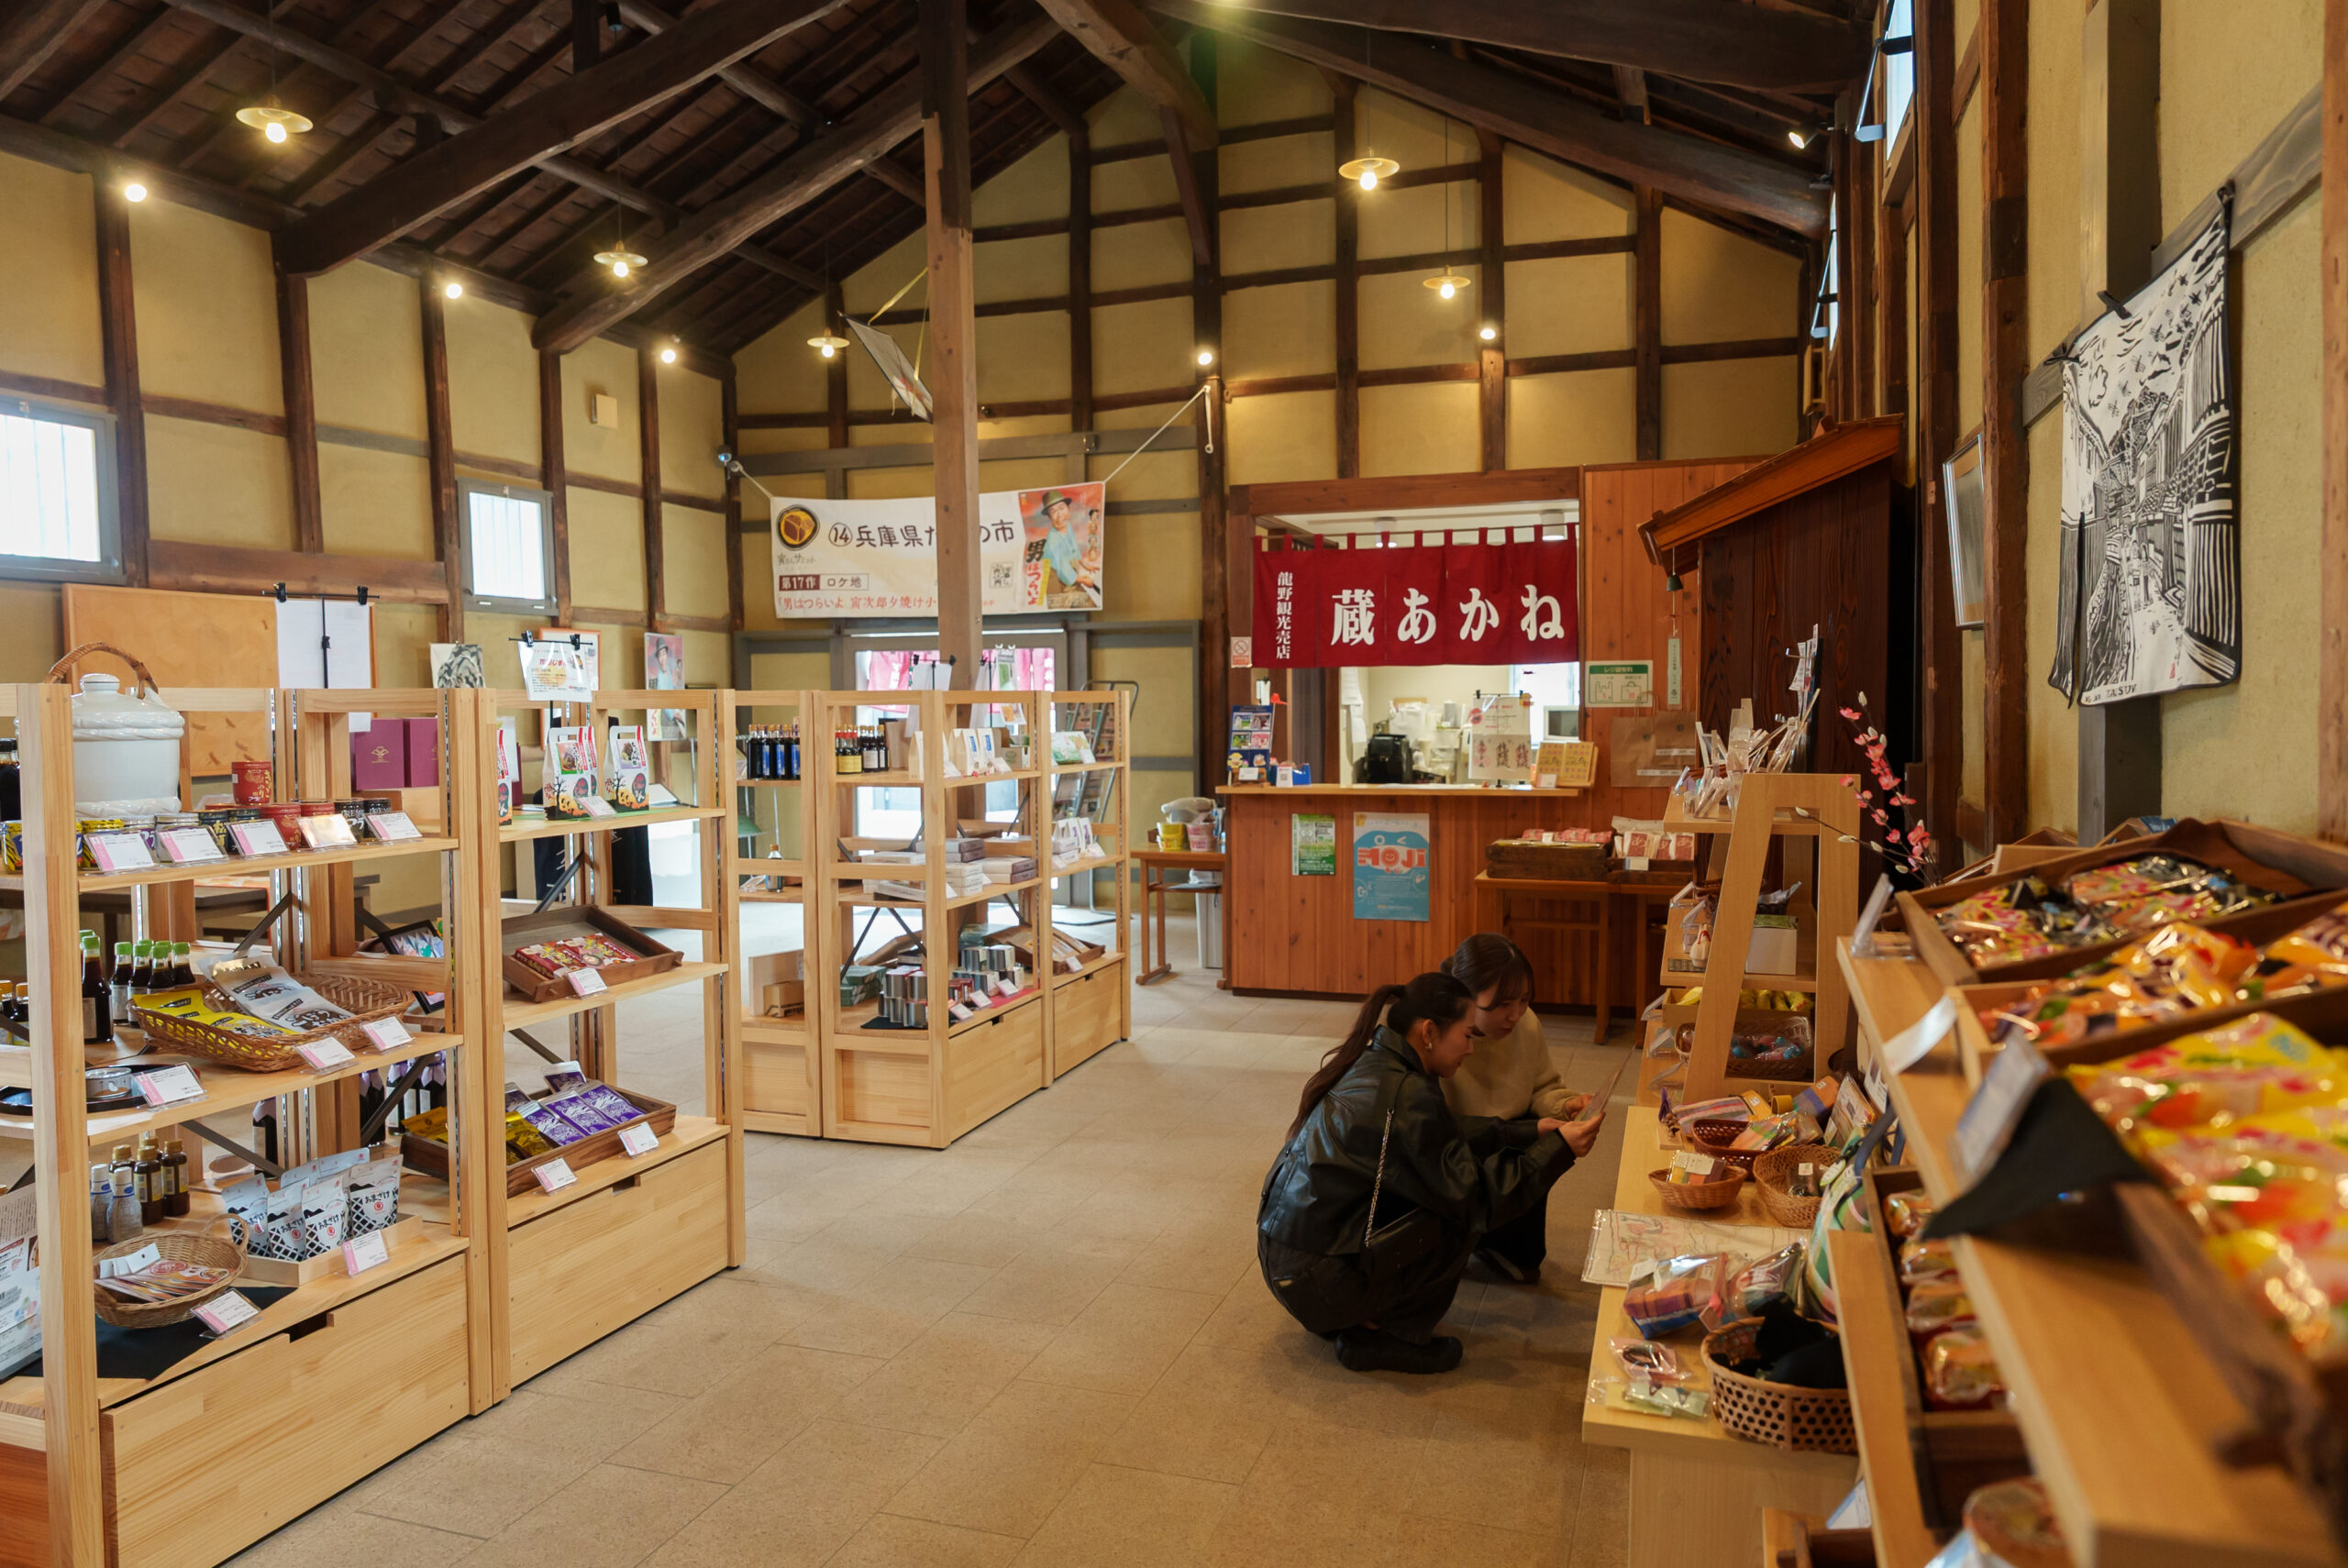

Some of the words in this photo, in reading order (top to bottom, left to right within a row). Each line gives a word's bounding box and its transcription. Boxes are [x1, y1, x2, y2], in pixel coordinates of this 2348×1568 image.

[781, 575, 817, 591] 第17作
[827, 576, 862, 589] ロケ地
[1275, 571, 1293, 660] 龍野観光売店
[1331, 584, 1565, 646] 蔵あかね
